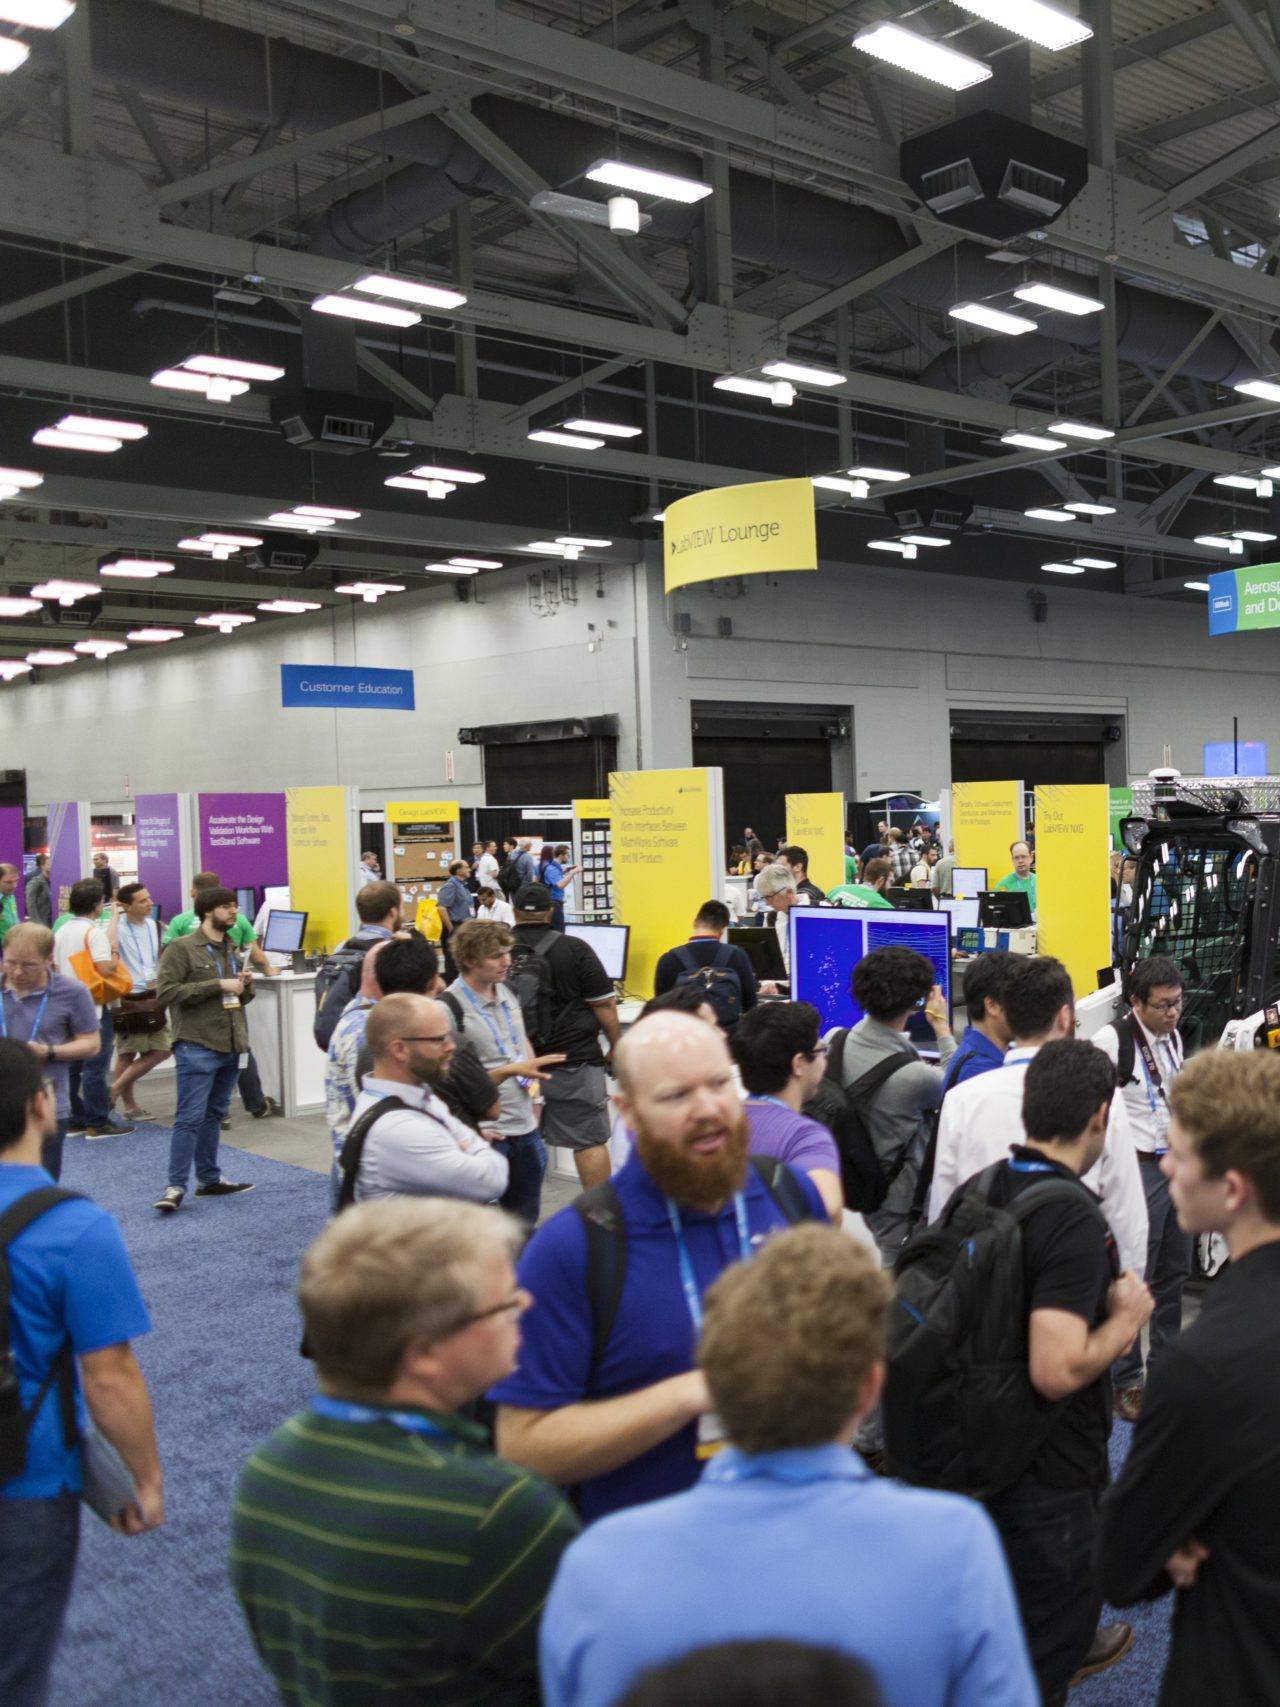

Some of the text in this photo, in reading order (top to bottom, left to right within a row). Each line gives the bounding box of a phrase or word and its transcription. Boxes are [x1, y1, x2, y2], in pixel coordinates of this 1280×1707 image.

[719, 521, 780, 543] Lounge
[1244, 601, 1265, 615] and
[300, 680, 403, 695] Customer Education
[237, 815, 246, 824] the
[246, 814, 265, 825] Design
[260, 825, 274, 833] With
[236, 836, 261, 845] Software
